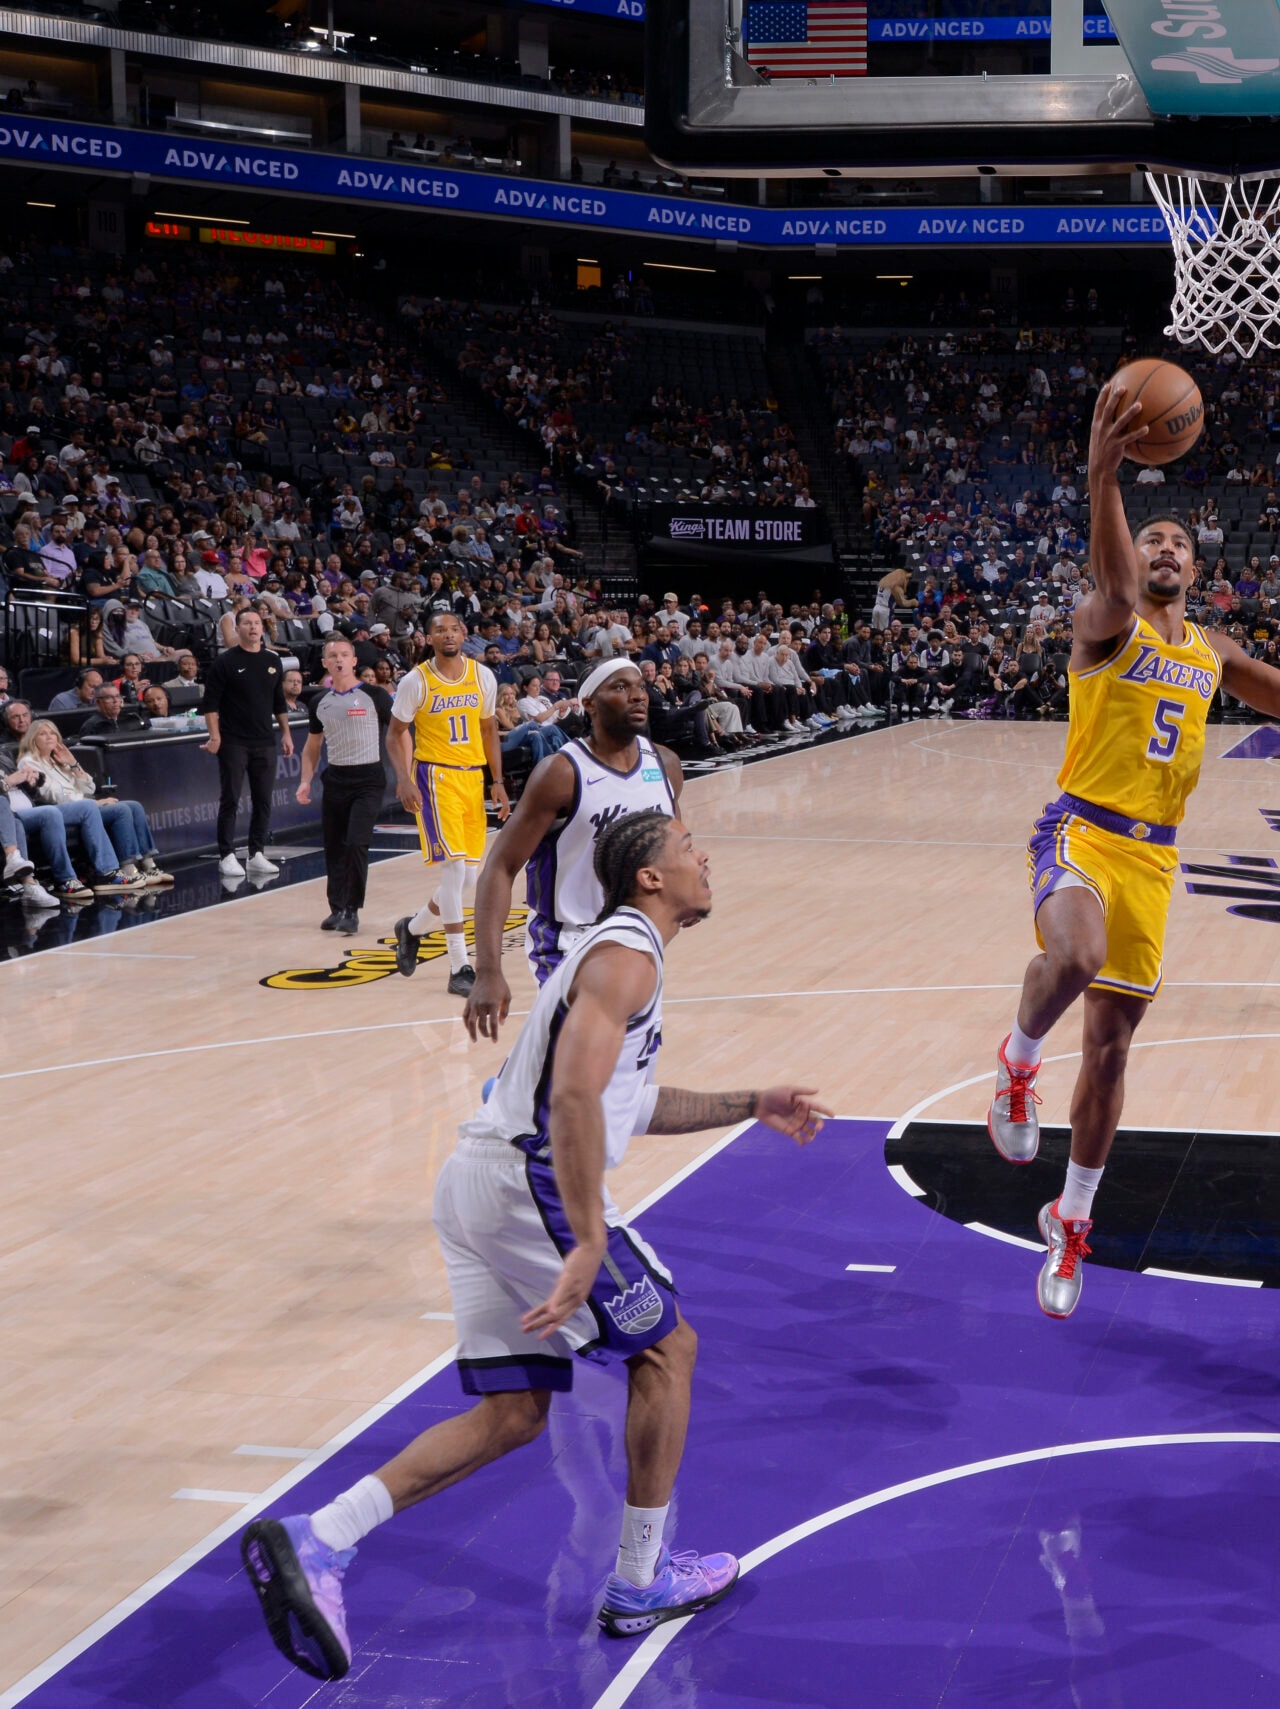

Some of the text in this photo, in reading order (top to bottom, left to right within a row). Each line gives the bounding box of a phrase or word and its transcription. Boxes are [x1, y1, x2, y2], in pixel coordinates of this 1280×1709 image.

[881, 22, 985, 38] ADVANCED
[0, 128, 123, 159] DVANCED
[164, 148, 299, 180] ADVANCED
[337, 169, 460, 199] ADVANCED
[494, 188, 607, 217] ADVANCED
[647, 207, 751, 233] ADVANCED
[781, 220, 887, 237] ADVANCED
[918, 218, 1025, 234] ADVANCED
[1056, 218, 1165, 234] ADVANCED
[668, 518, 803, 541] Kings TEAM STORE
[1118, 644, 1214, 699] LAKERS
[429, 692, 480, 714] LAKERS
[448, 714, 471, 746] 11
[1145, 697, 1186, 763] 5
[616, 1294, 660, 1326] KINGS
